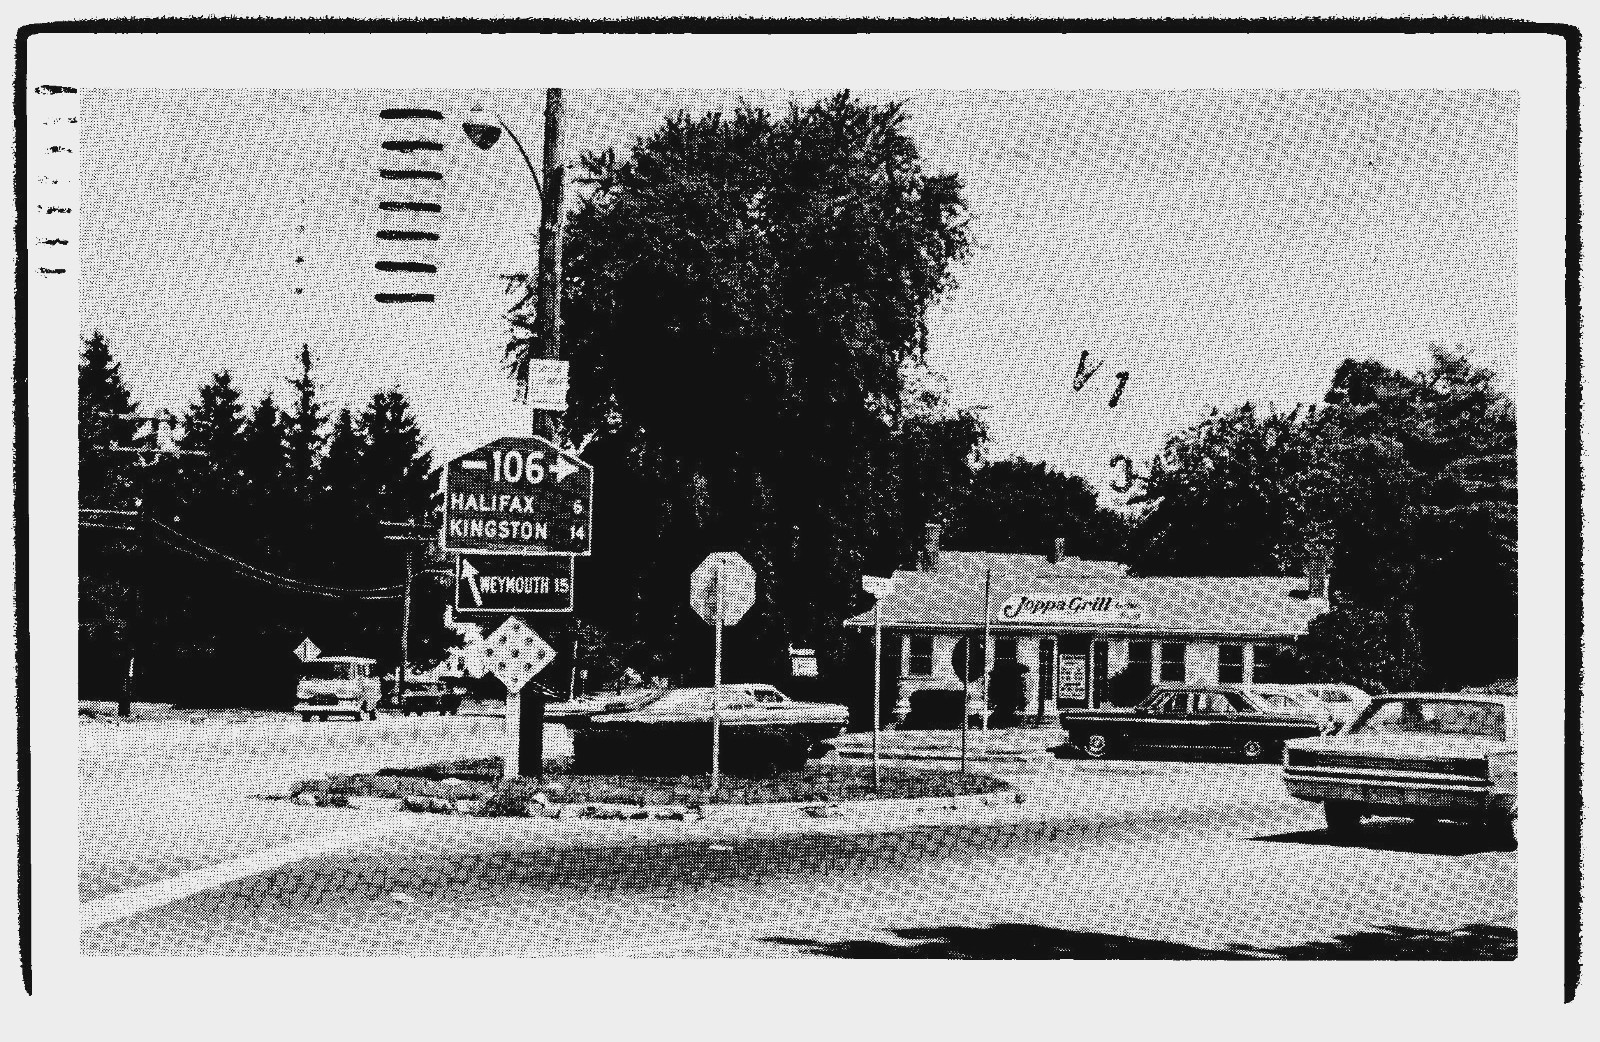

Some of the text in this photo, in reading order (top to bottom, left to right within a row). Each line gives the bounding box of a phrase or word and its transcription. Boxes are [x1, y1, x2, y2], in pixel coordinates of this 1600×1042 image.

[493, 451, 544, 484] 106
[450, 493, 583, 514] HALIFAX 6
[450, 519, 584, 540] KINGSTON 14
[480, 576, 569, 594] WEYMOUTH 15
[1004, 596, 1066, 618] Joppa
[1068, 596, 1112, 614] Grill
